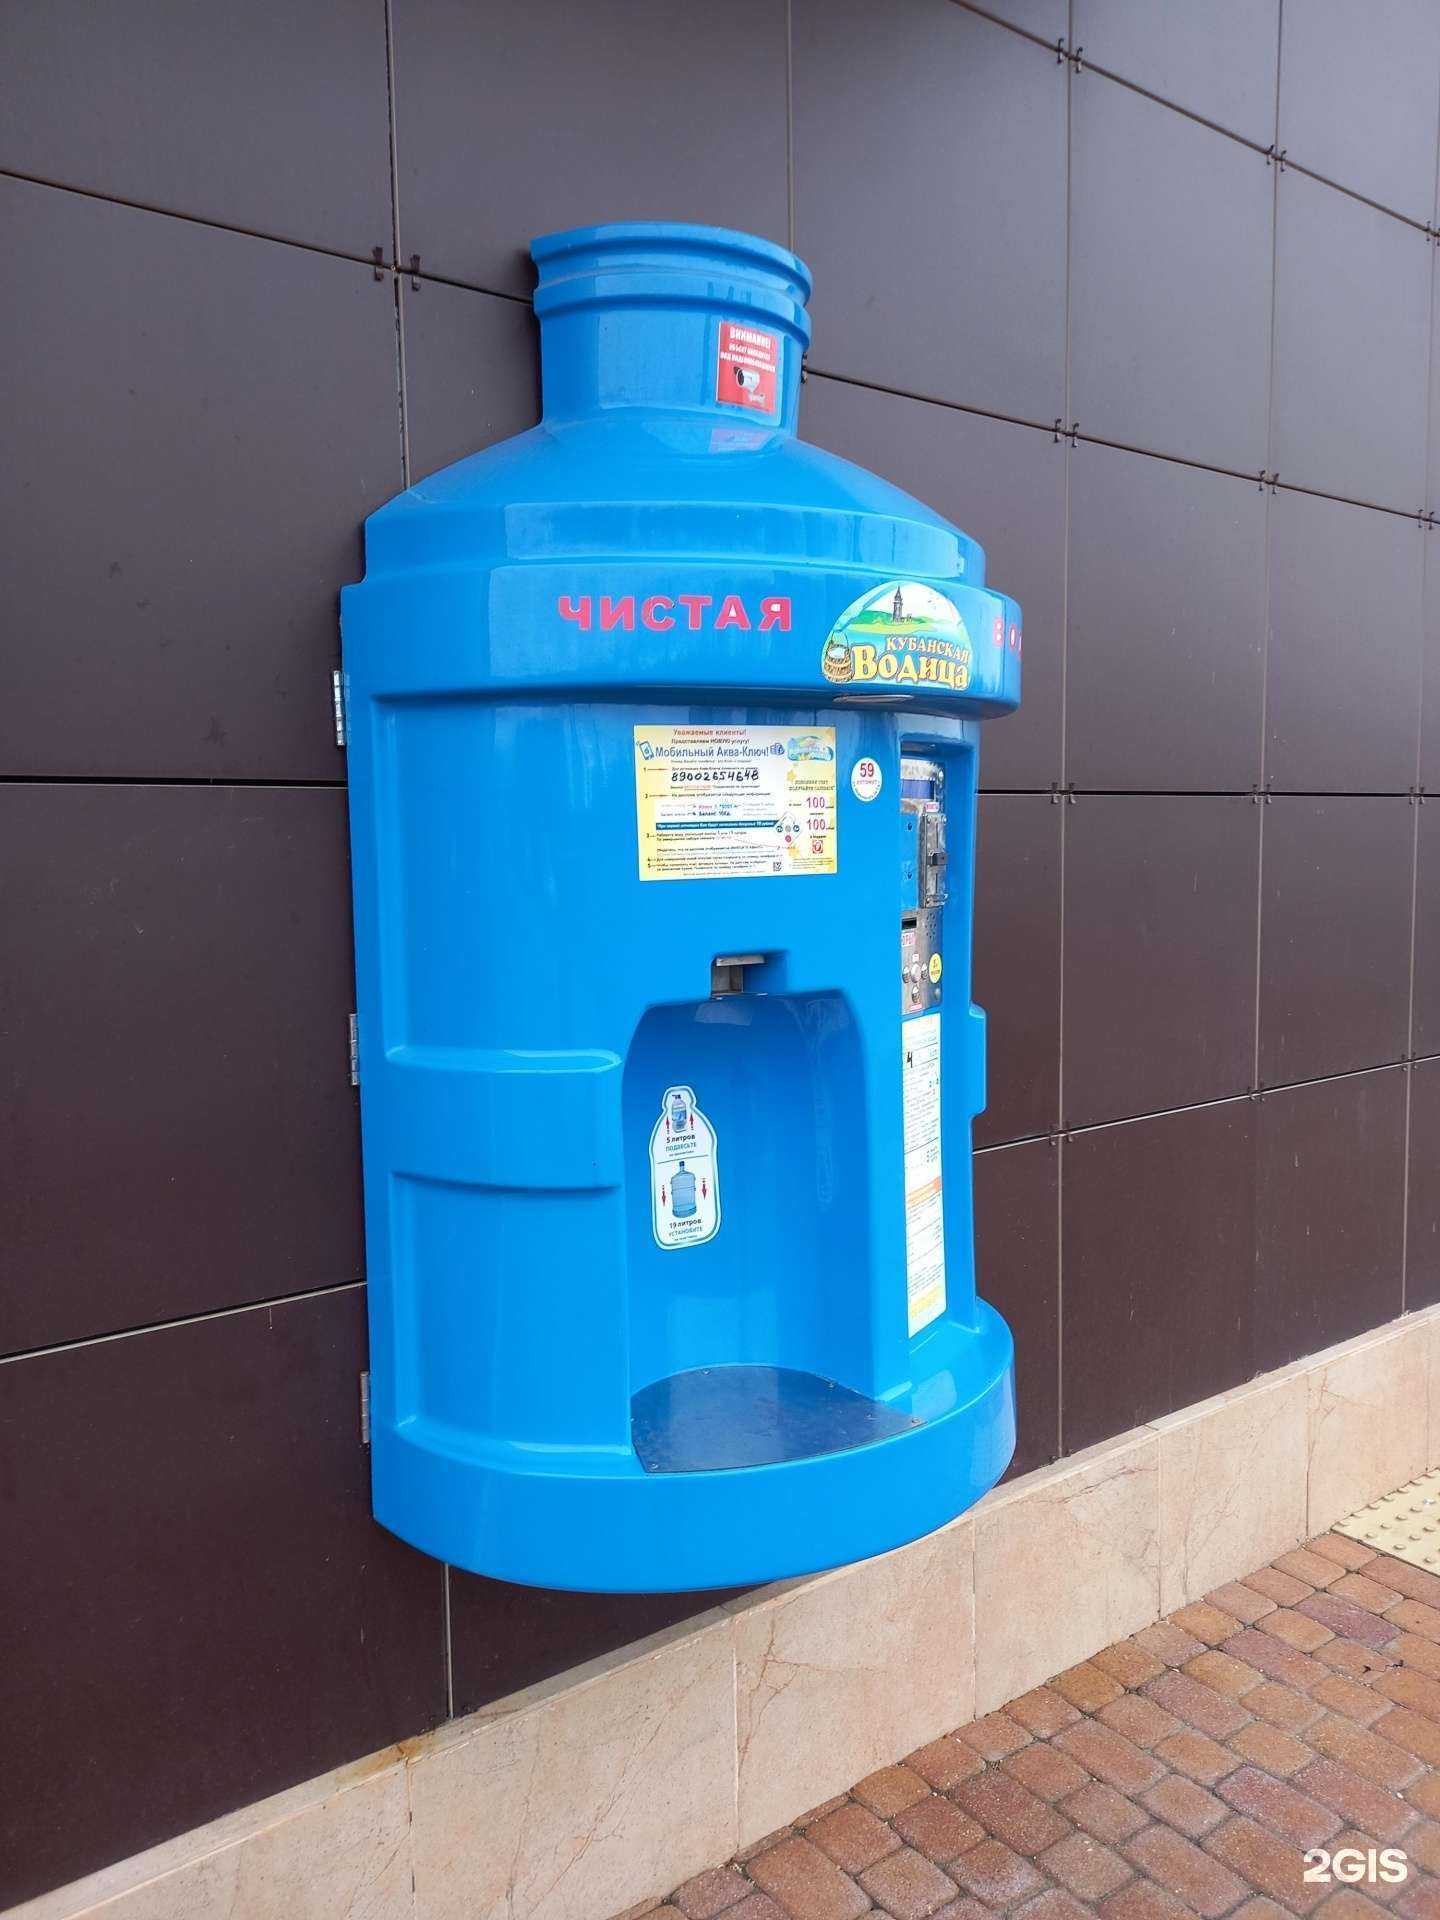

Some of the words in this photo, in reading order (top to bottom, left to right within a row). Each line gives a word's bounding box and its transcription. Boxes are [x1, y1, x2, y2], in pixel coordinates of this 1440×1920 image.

[559, 595, 792, 631] ЧИСТАЯ
[886, 636, 969, 664] КУБАНСКАЯ
[655, 746, 714, 758] Мобильный
[716, 747, 769, 758] Аква-Ключ!
[860, 763, 874, 777] 59
[806, 797, 826, 809] 100
[806, 818, 826, 831] 100
[666, 1136, 671, 1144] 5
[671, 1134, 695, 1144] литров
[669, 1222, 677, 1230] 19
[677, 1219, 702, 1227] литров
